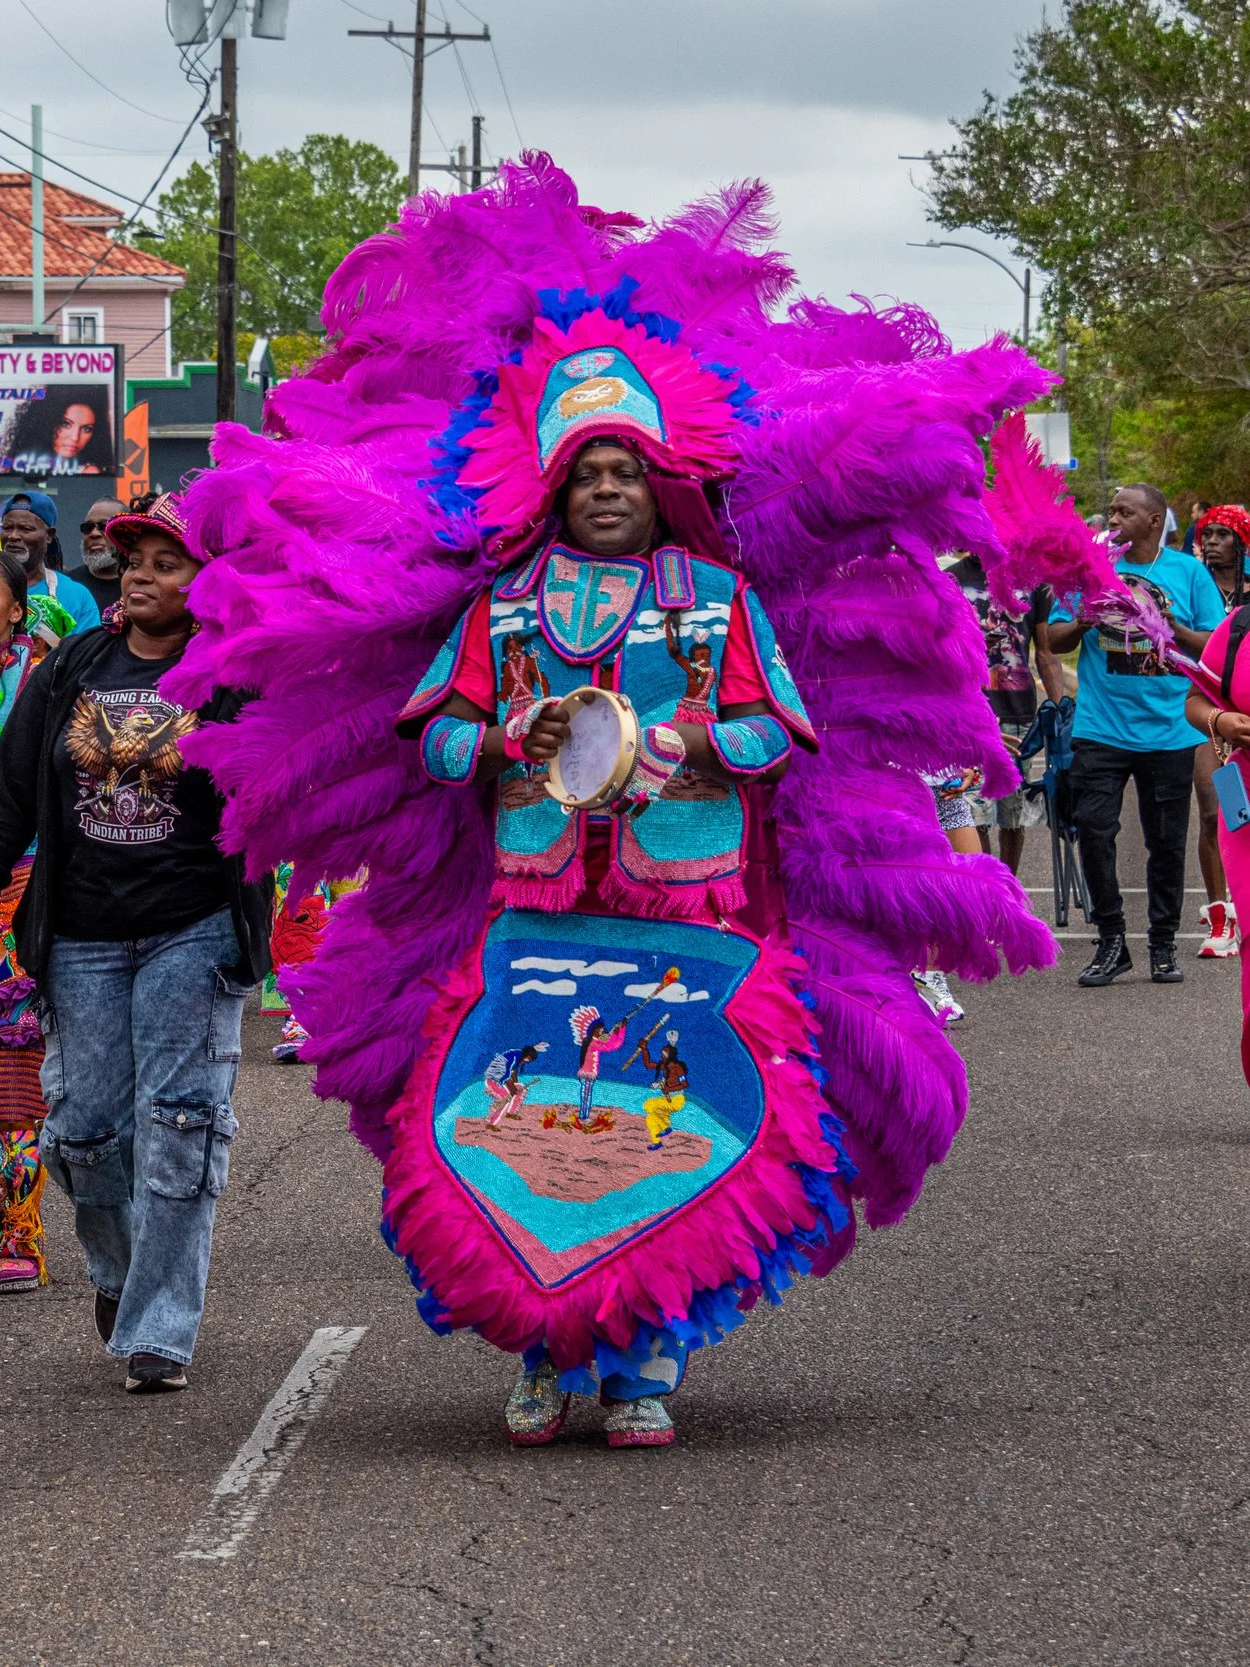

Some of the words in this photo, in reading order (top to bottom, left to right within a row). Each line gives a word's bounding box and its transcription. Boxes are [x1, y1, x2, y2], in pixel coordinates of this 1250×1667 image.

[26, 353, 36, 374] &
[41, 352, 114, 374] BEYOND
[95, 692, 137, 704] YOUNG
[139, 692, 183, 718] EAGS
[90, 823, 127, 841] INDIAN
[130, 825, 163, 841] TRIBE
